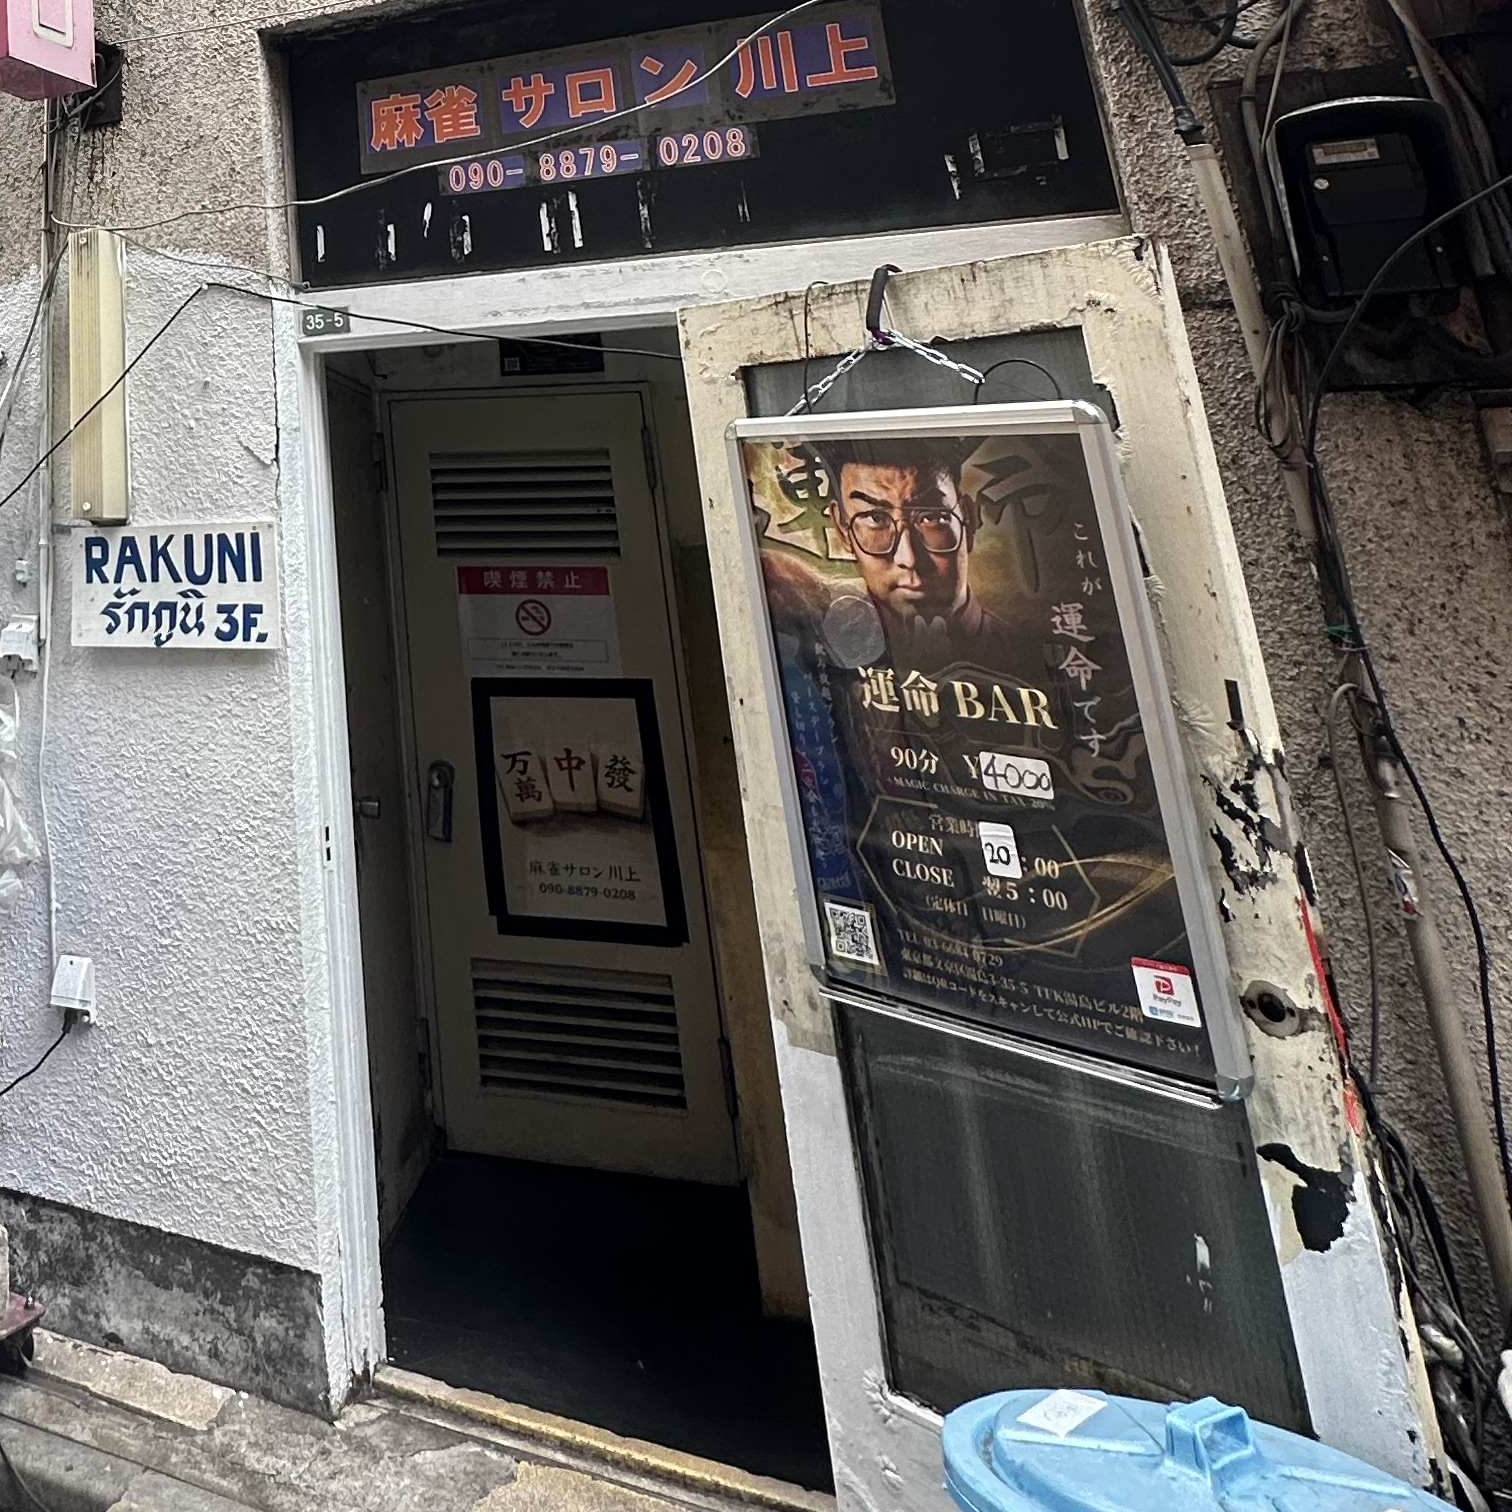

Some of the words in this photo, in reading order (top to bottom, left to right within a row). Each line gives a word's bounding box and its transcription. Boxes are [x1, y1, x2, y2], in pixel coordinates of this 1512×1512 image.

[306, 312, 344, 330] 35-5
[84, 531, 263, 586] RAKUNI
[483, 570, 582, 590] 喫煙禁止
[858, 666, 939, 717] 運命
[951, 680, 1059, 730] BAR
[554, 747, 587, 793] 中
[890, 746, 939, 775] 90分
[929, 813, 980, 839] 営業時
[891, 830, 944, 857] OPEN
[529, 860, 642, 883] 麻雀サロン川上
[891, 858, 955, 888] CLOSE
